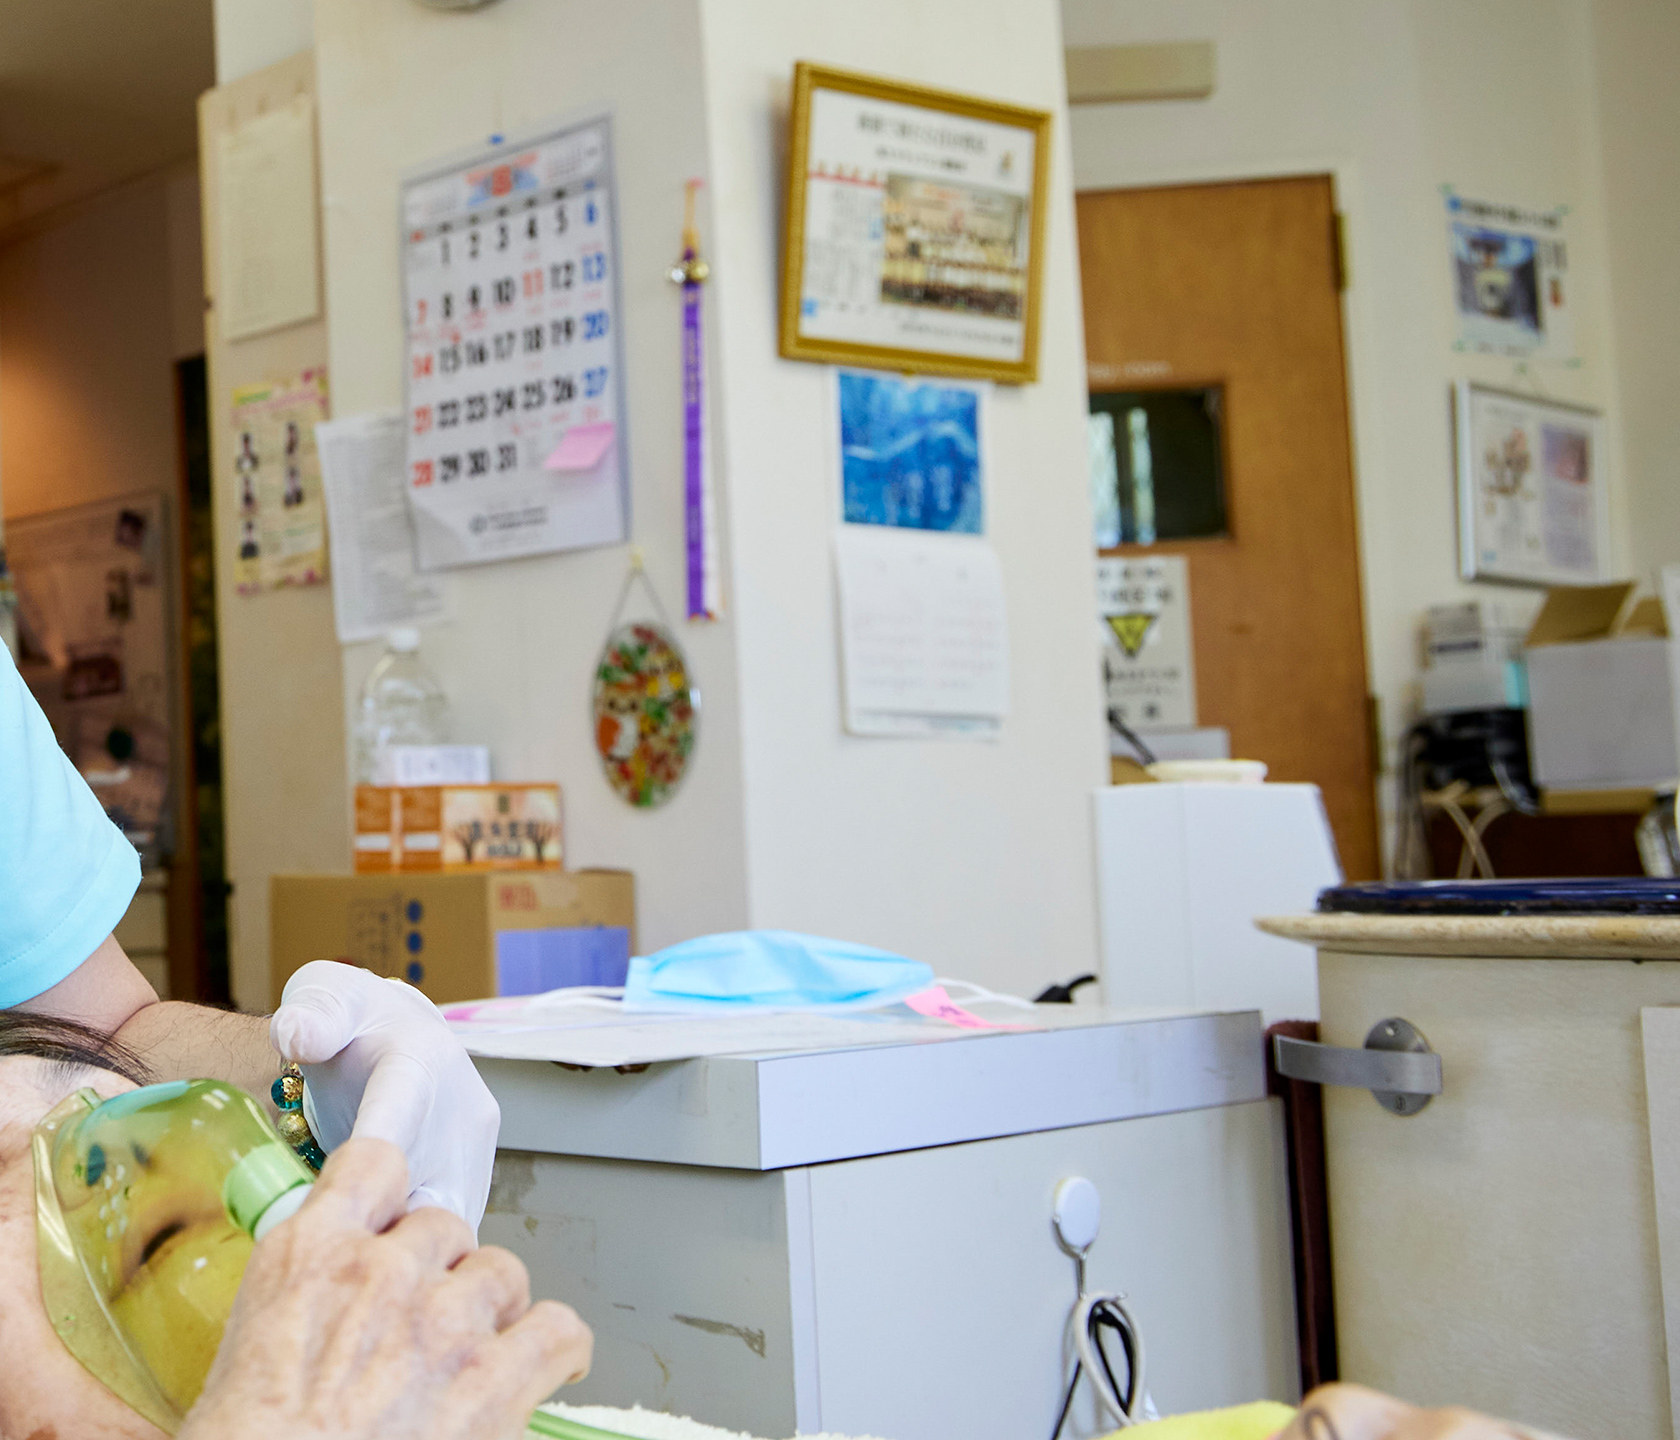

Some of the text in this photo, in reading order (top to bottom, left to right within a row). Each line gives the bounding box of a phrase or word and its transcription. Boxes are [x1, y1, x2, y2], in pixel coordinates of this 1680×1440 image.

[468, 230, 480, 258] 2
[495, 222, 509, 252] 3
[525, 216, 537, 240] 4
[556, 205, 568, 234] 5
[442, 294, 453, 320] 8
[469, 286, 481, 312] 9
[493, 277, 515, 303] 10
[522, 268, 543, 297] 11
[551, 261, 574, 289] 12
[582, 253, 606, 281] 13
[413, 310, 609, 379] 14 15 16 17 18 19 20
[414, 367, 607, 435] 21 22 23 24 25 26 27
[413, 443, 516, 487] 28 29 30 31
